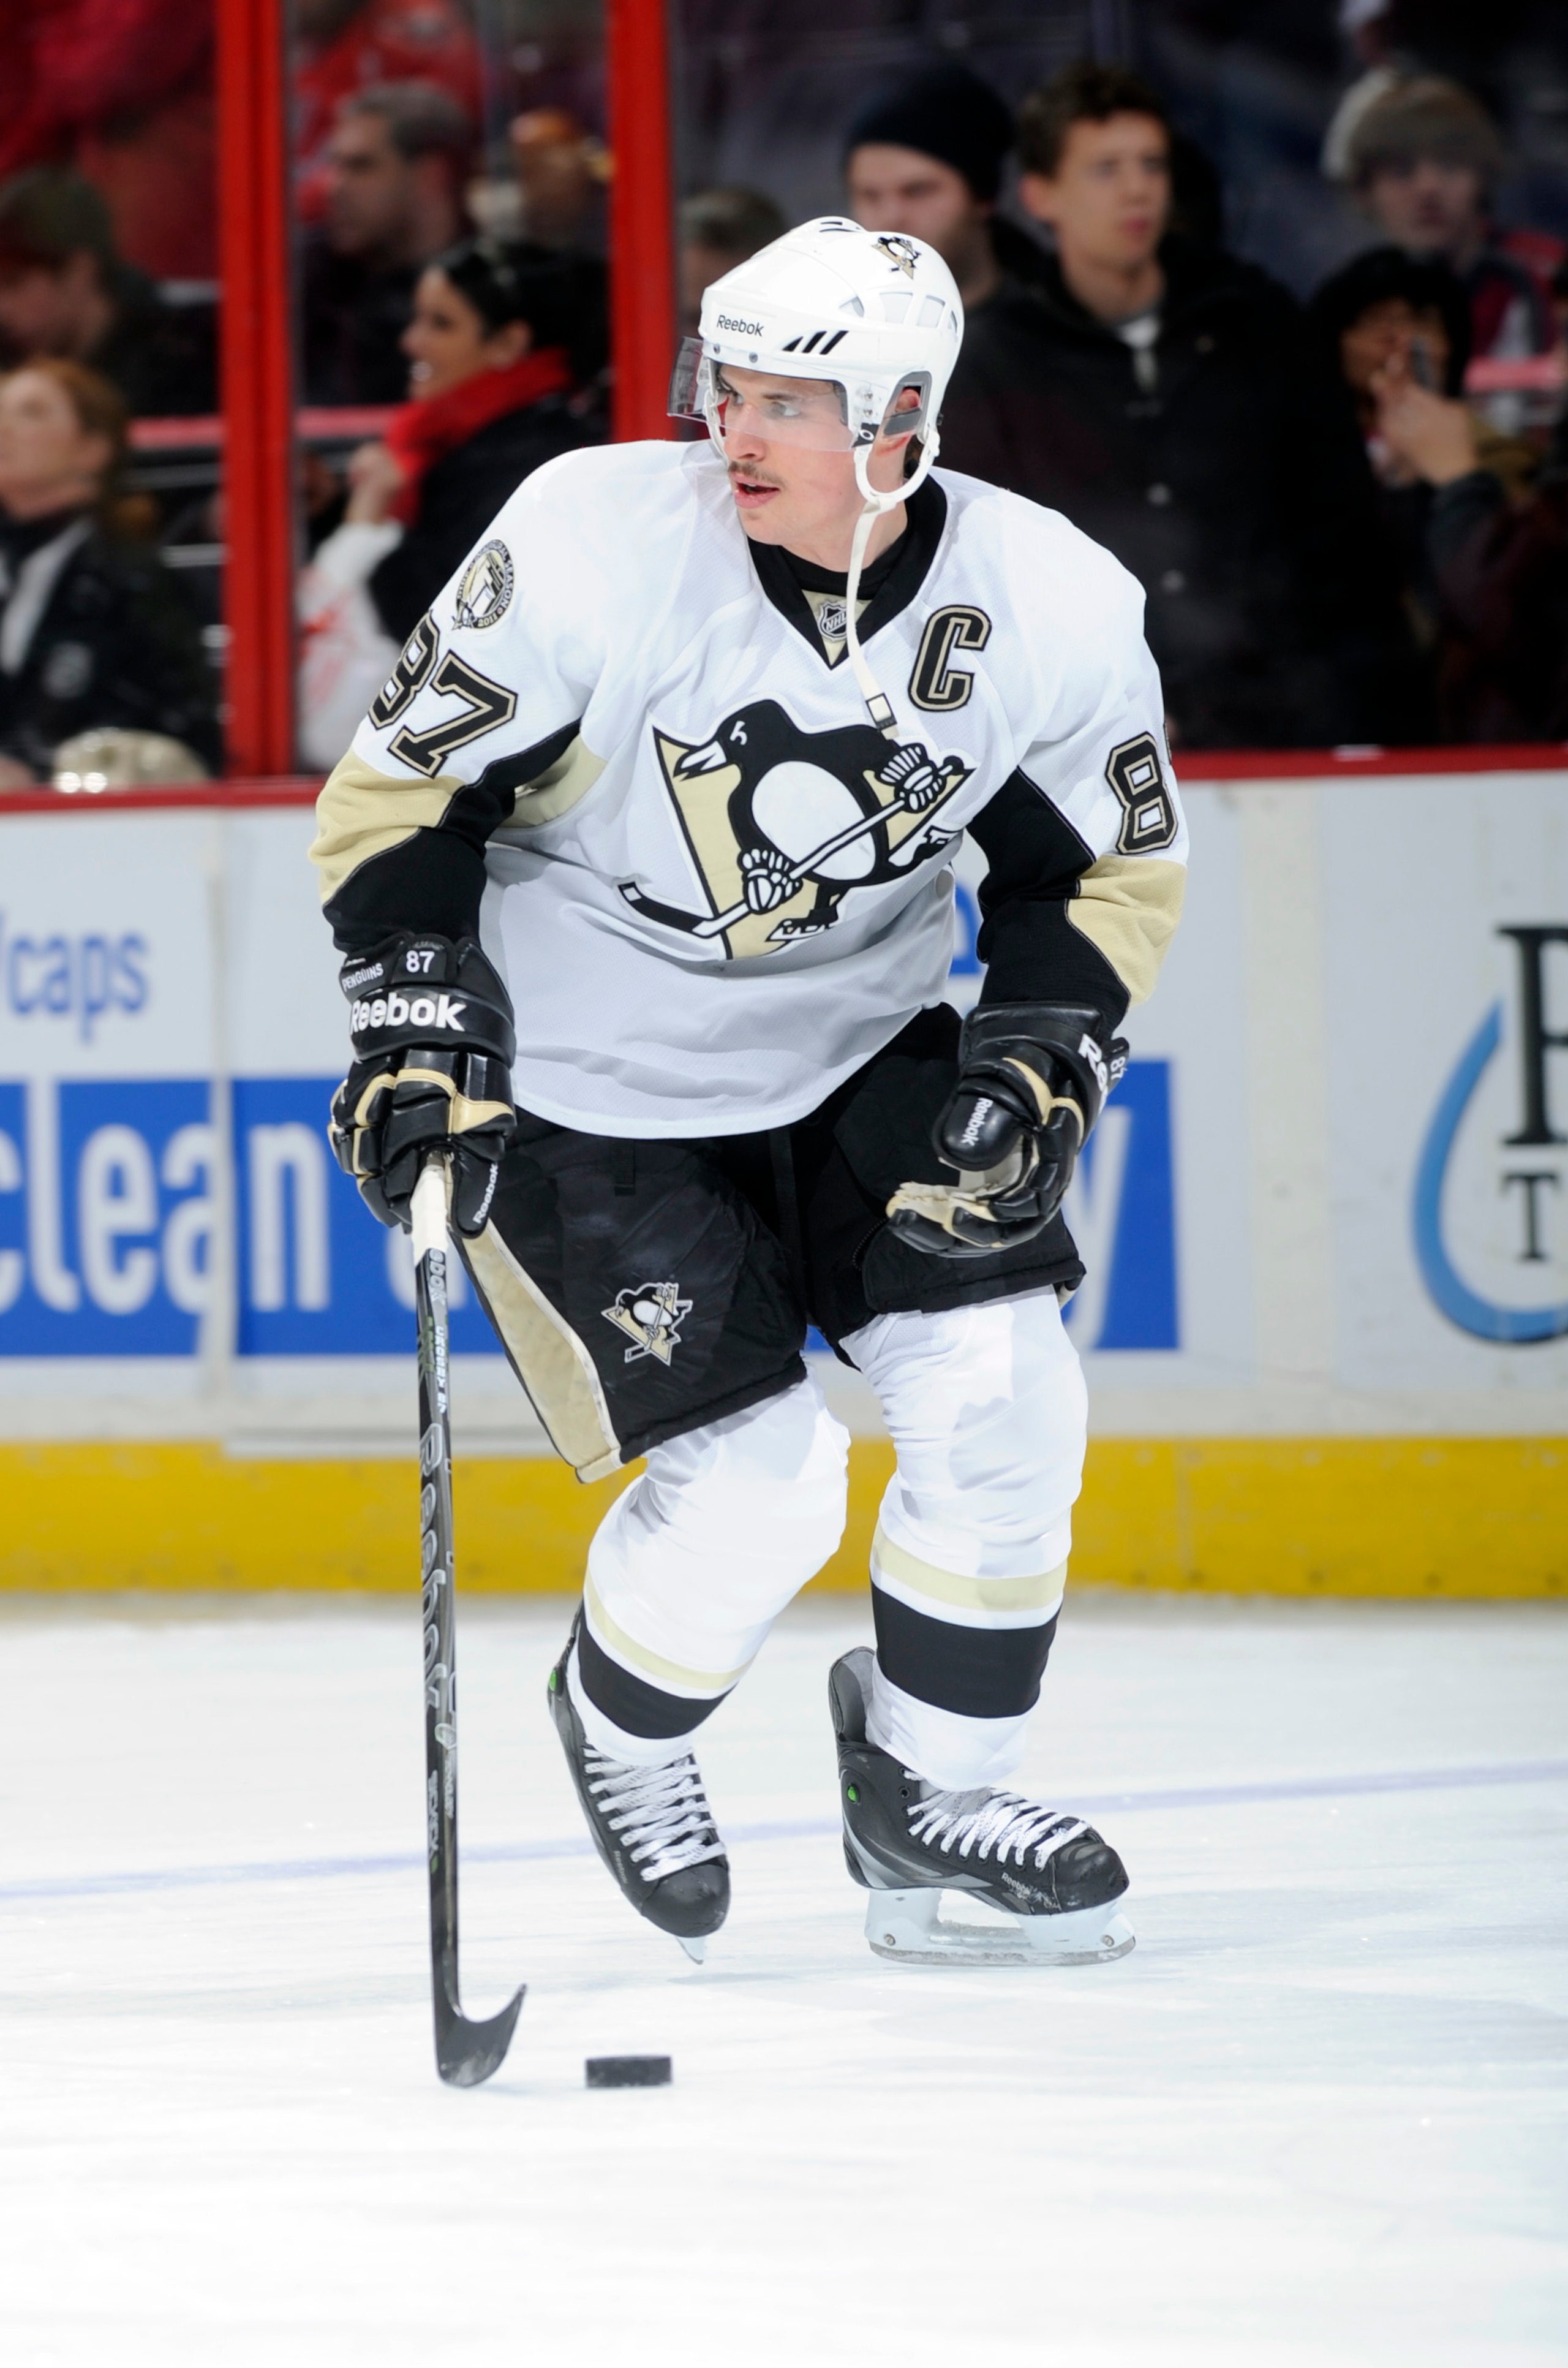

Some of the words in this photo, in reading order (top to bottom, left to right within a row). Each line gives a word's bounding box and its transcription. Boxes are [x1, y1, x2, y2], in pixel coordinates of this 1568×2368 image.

[716, 314, 764, 337] Reebok
[477, 612, 499, 628] 2011
[908, 604, 992, 713] C
[1104, 718, 1179, 855] 8
[341, 962, 384, 993] PENGUINS
[405, 949, 435, 974] 87
[349, 991, 467, 1036] Reebok
[960, 1097, 994, 1147] Reebok
[472, 1162, 499, 1224] Reebok
[435, 1325, 447, 1388] CROSBY
